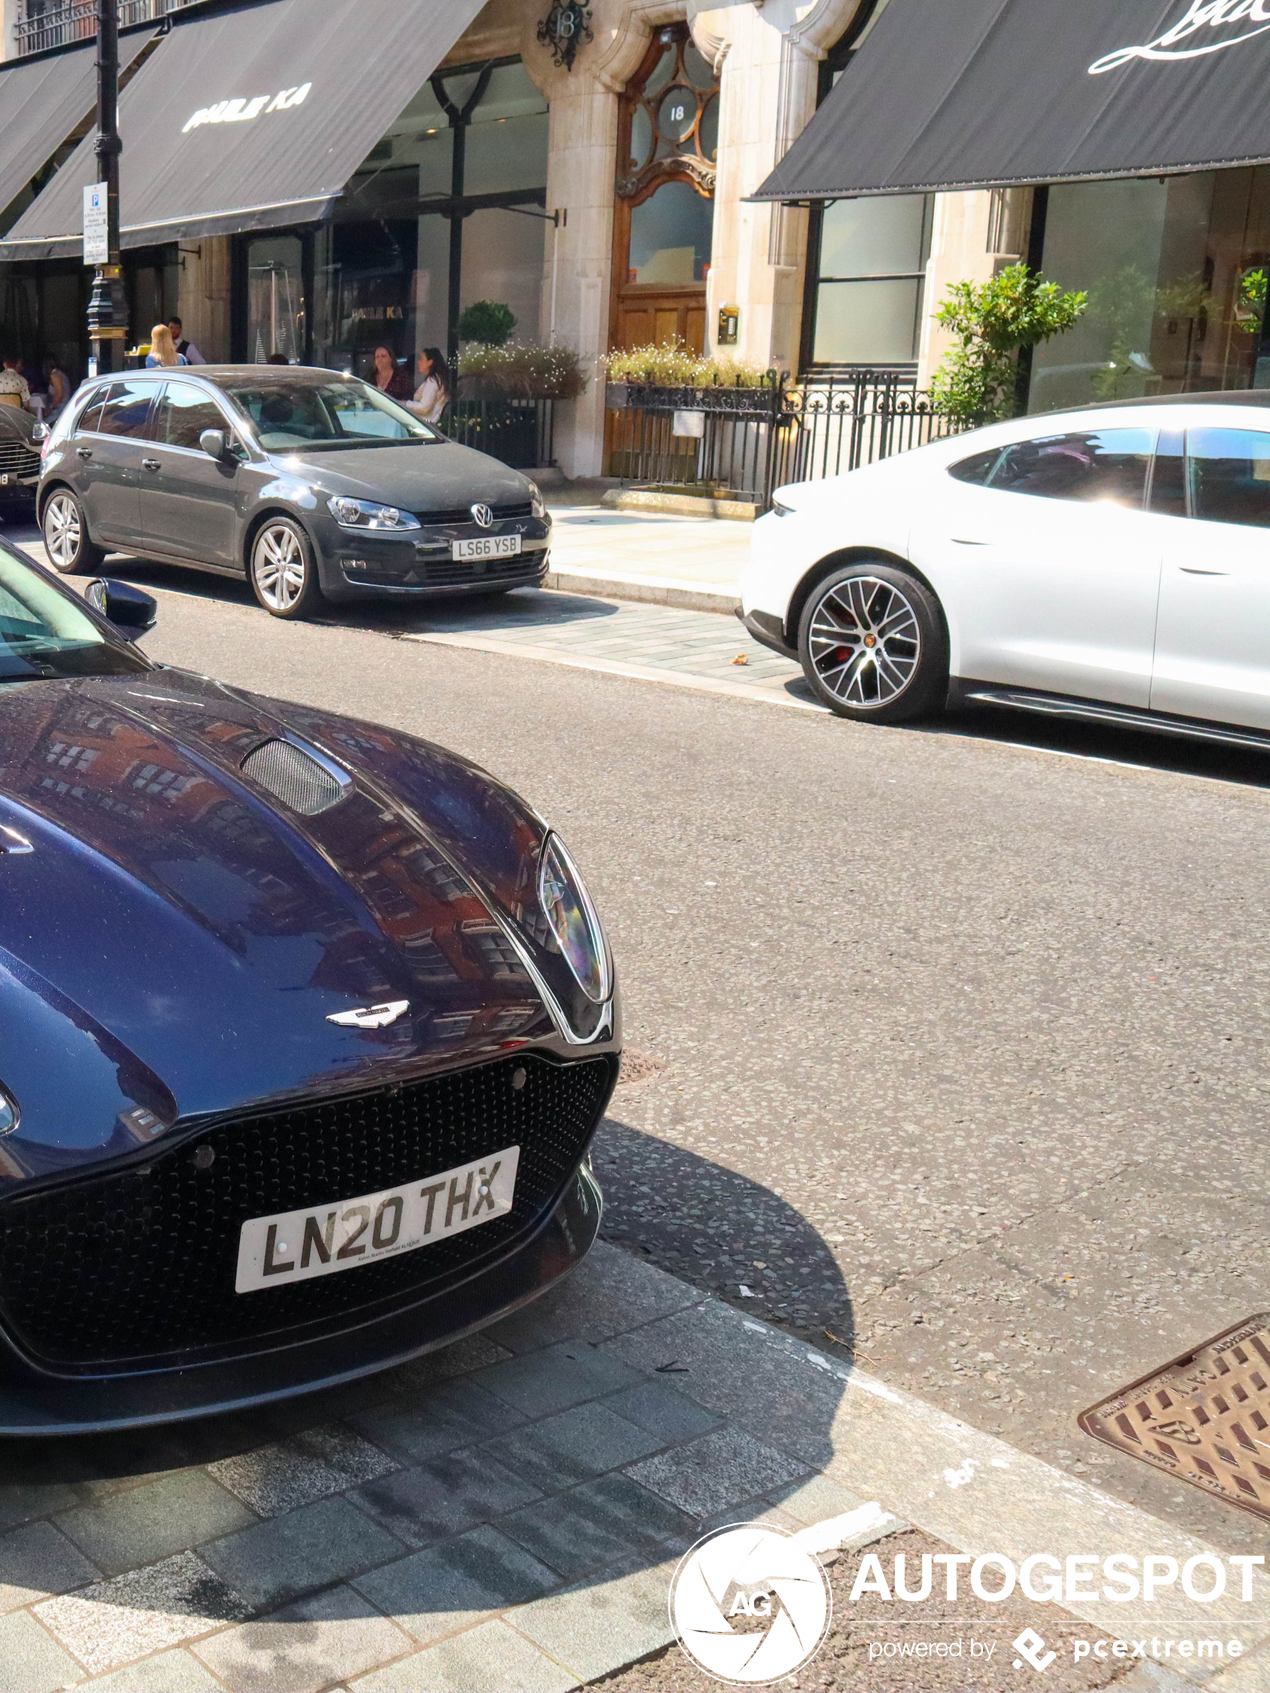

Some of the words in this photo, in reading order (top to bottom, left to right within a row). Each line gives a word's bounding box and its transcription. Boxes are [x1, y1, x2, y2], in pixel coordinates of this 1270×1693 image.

[182, 95, 270, 133] PAULE
[265, 82, 312, 113] KA
[671, 106, 684, 121] 18
[458, 540, 491, 557] LS66
[494, 537, 517, 553] YSB
[262, 1195, 405, 1276] LN20
[420, 1160, 502, 1236] THX
